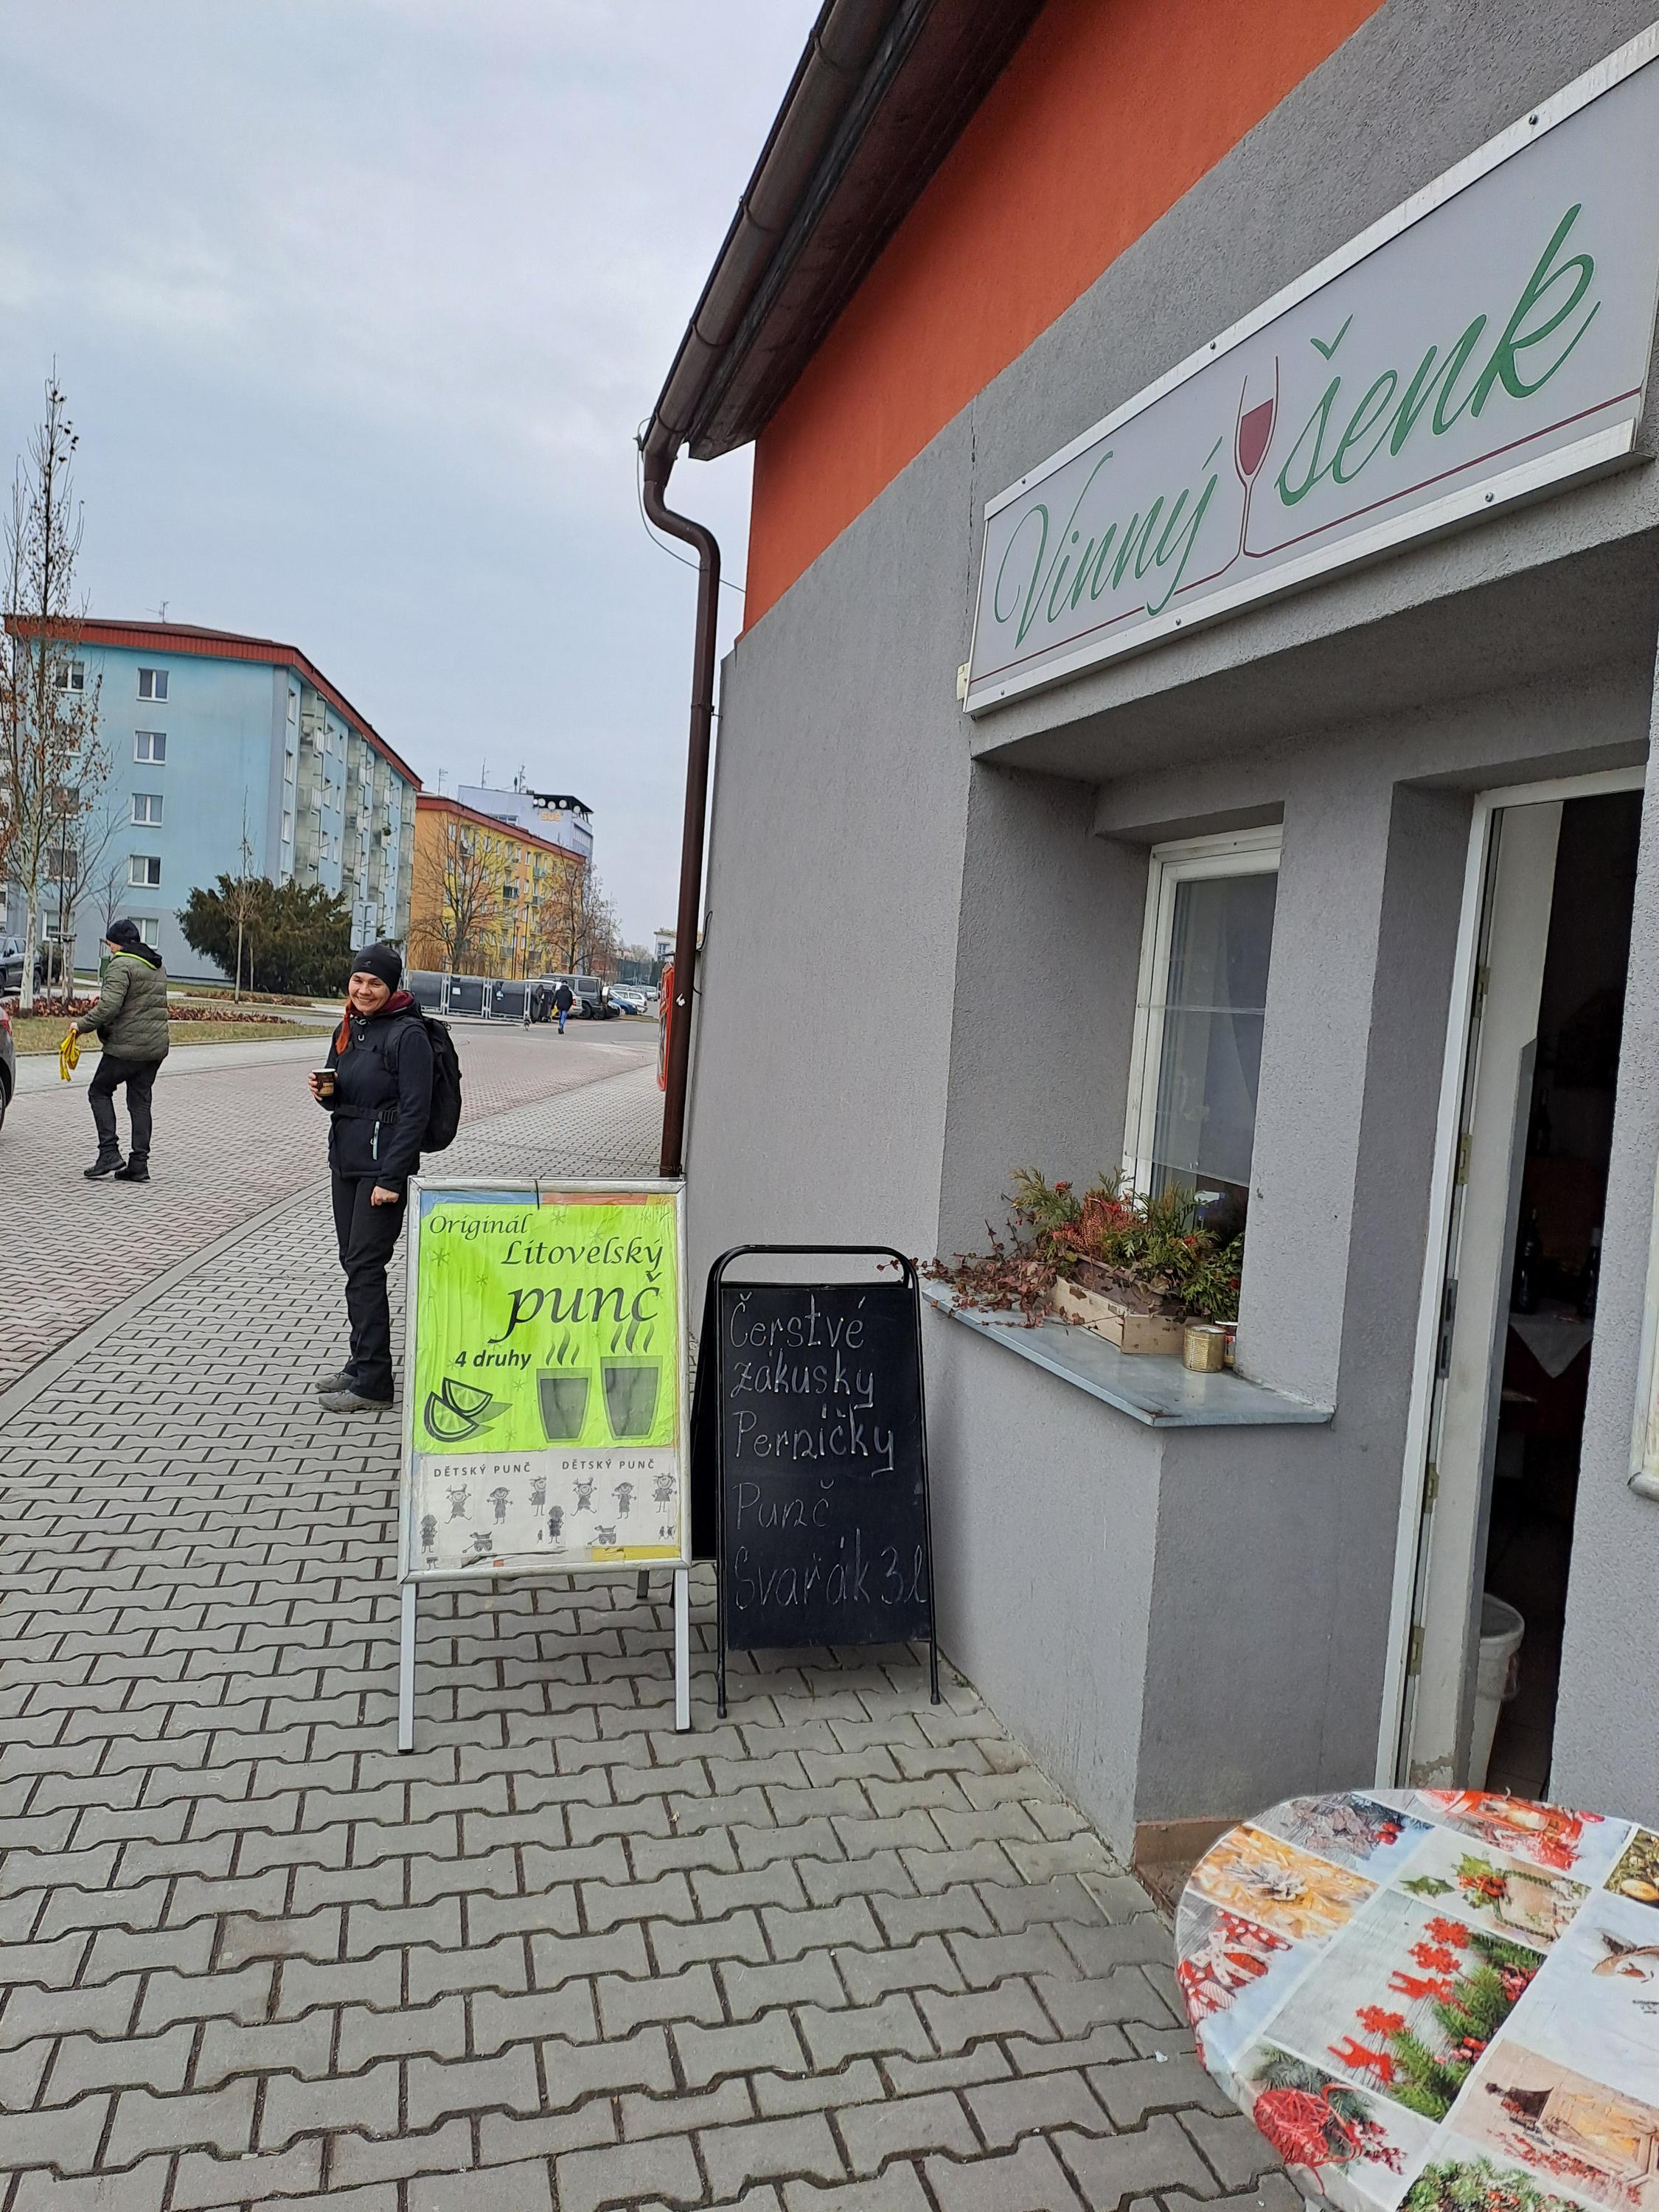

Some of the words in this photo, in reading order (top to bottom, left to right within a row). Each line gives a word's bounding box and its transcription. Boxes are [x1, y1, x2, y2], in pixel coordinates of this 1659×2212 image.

[992, 436, 1224, 650] Vinný
[1274, 202, 1601, 508] šenk
[430, 1213, 534, 1241] Originál
[501, 1237, 663, 1272] Litovelský
[487, 1269, 662, 1344] punč
[730, 1291, 866, 1349] Čerstvé
[454, 1350, 466, 1368] 4
[473, 1349, 532, 1370] druhy
[731, 1403, 894, 1477] Perníčky
[434, 1464, 487, 1478] DĚTSKÝ
[493, 1461, 532, 1474] PUNČ
[562, 1458, 613, 1471] DĚTSKÝ
[619, 1458, 655, 1470] PUNČ
[731, 1479, 835, 1530] Punč
